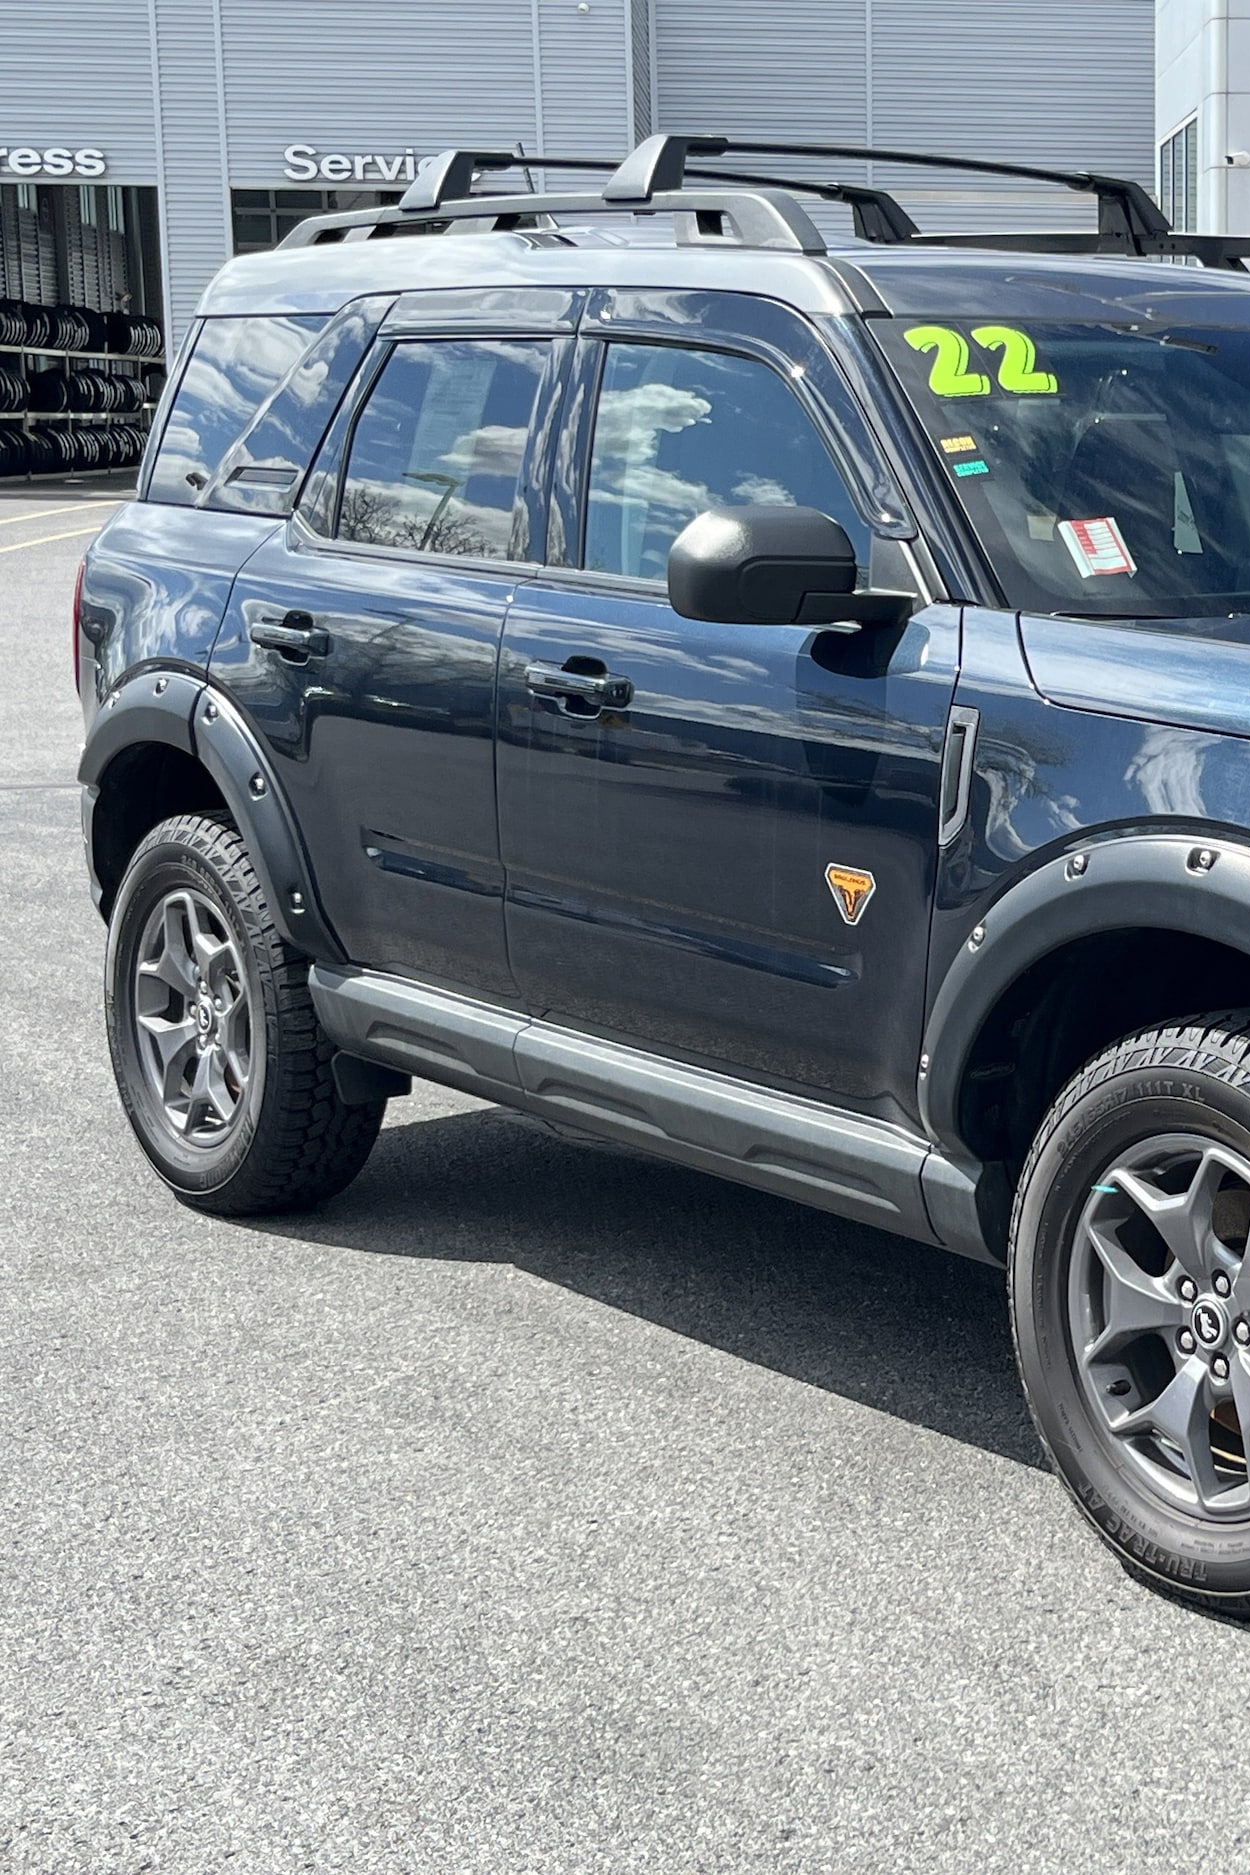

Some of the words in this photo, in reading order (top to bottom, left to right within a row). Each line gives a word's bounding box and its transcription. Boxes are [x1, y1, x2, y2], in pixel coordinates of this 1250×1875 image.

[283, 143, 481, 182] Servi
[903, 326, 1058, 397] 22
[1136, 1080, 1174, 1096] 111T
[1181, 1082, 1206, 1101] XL
